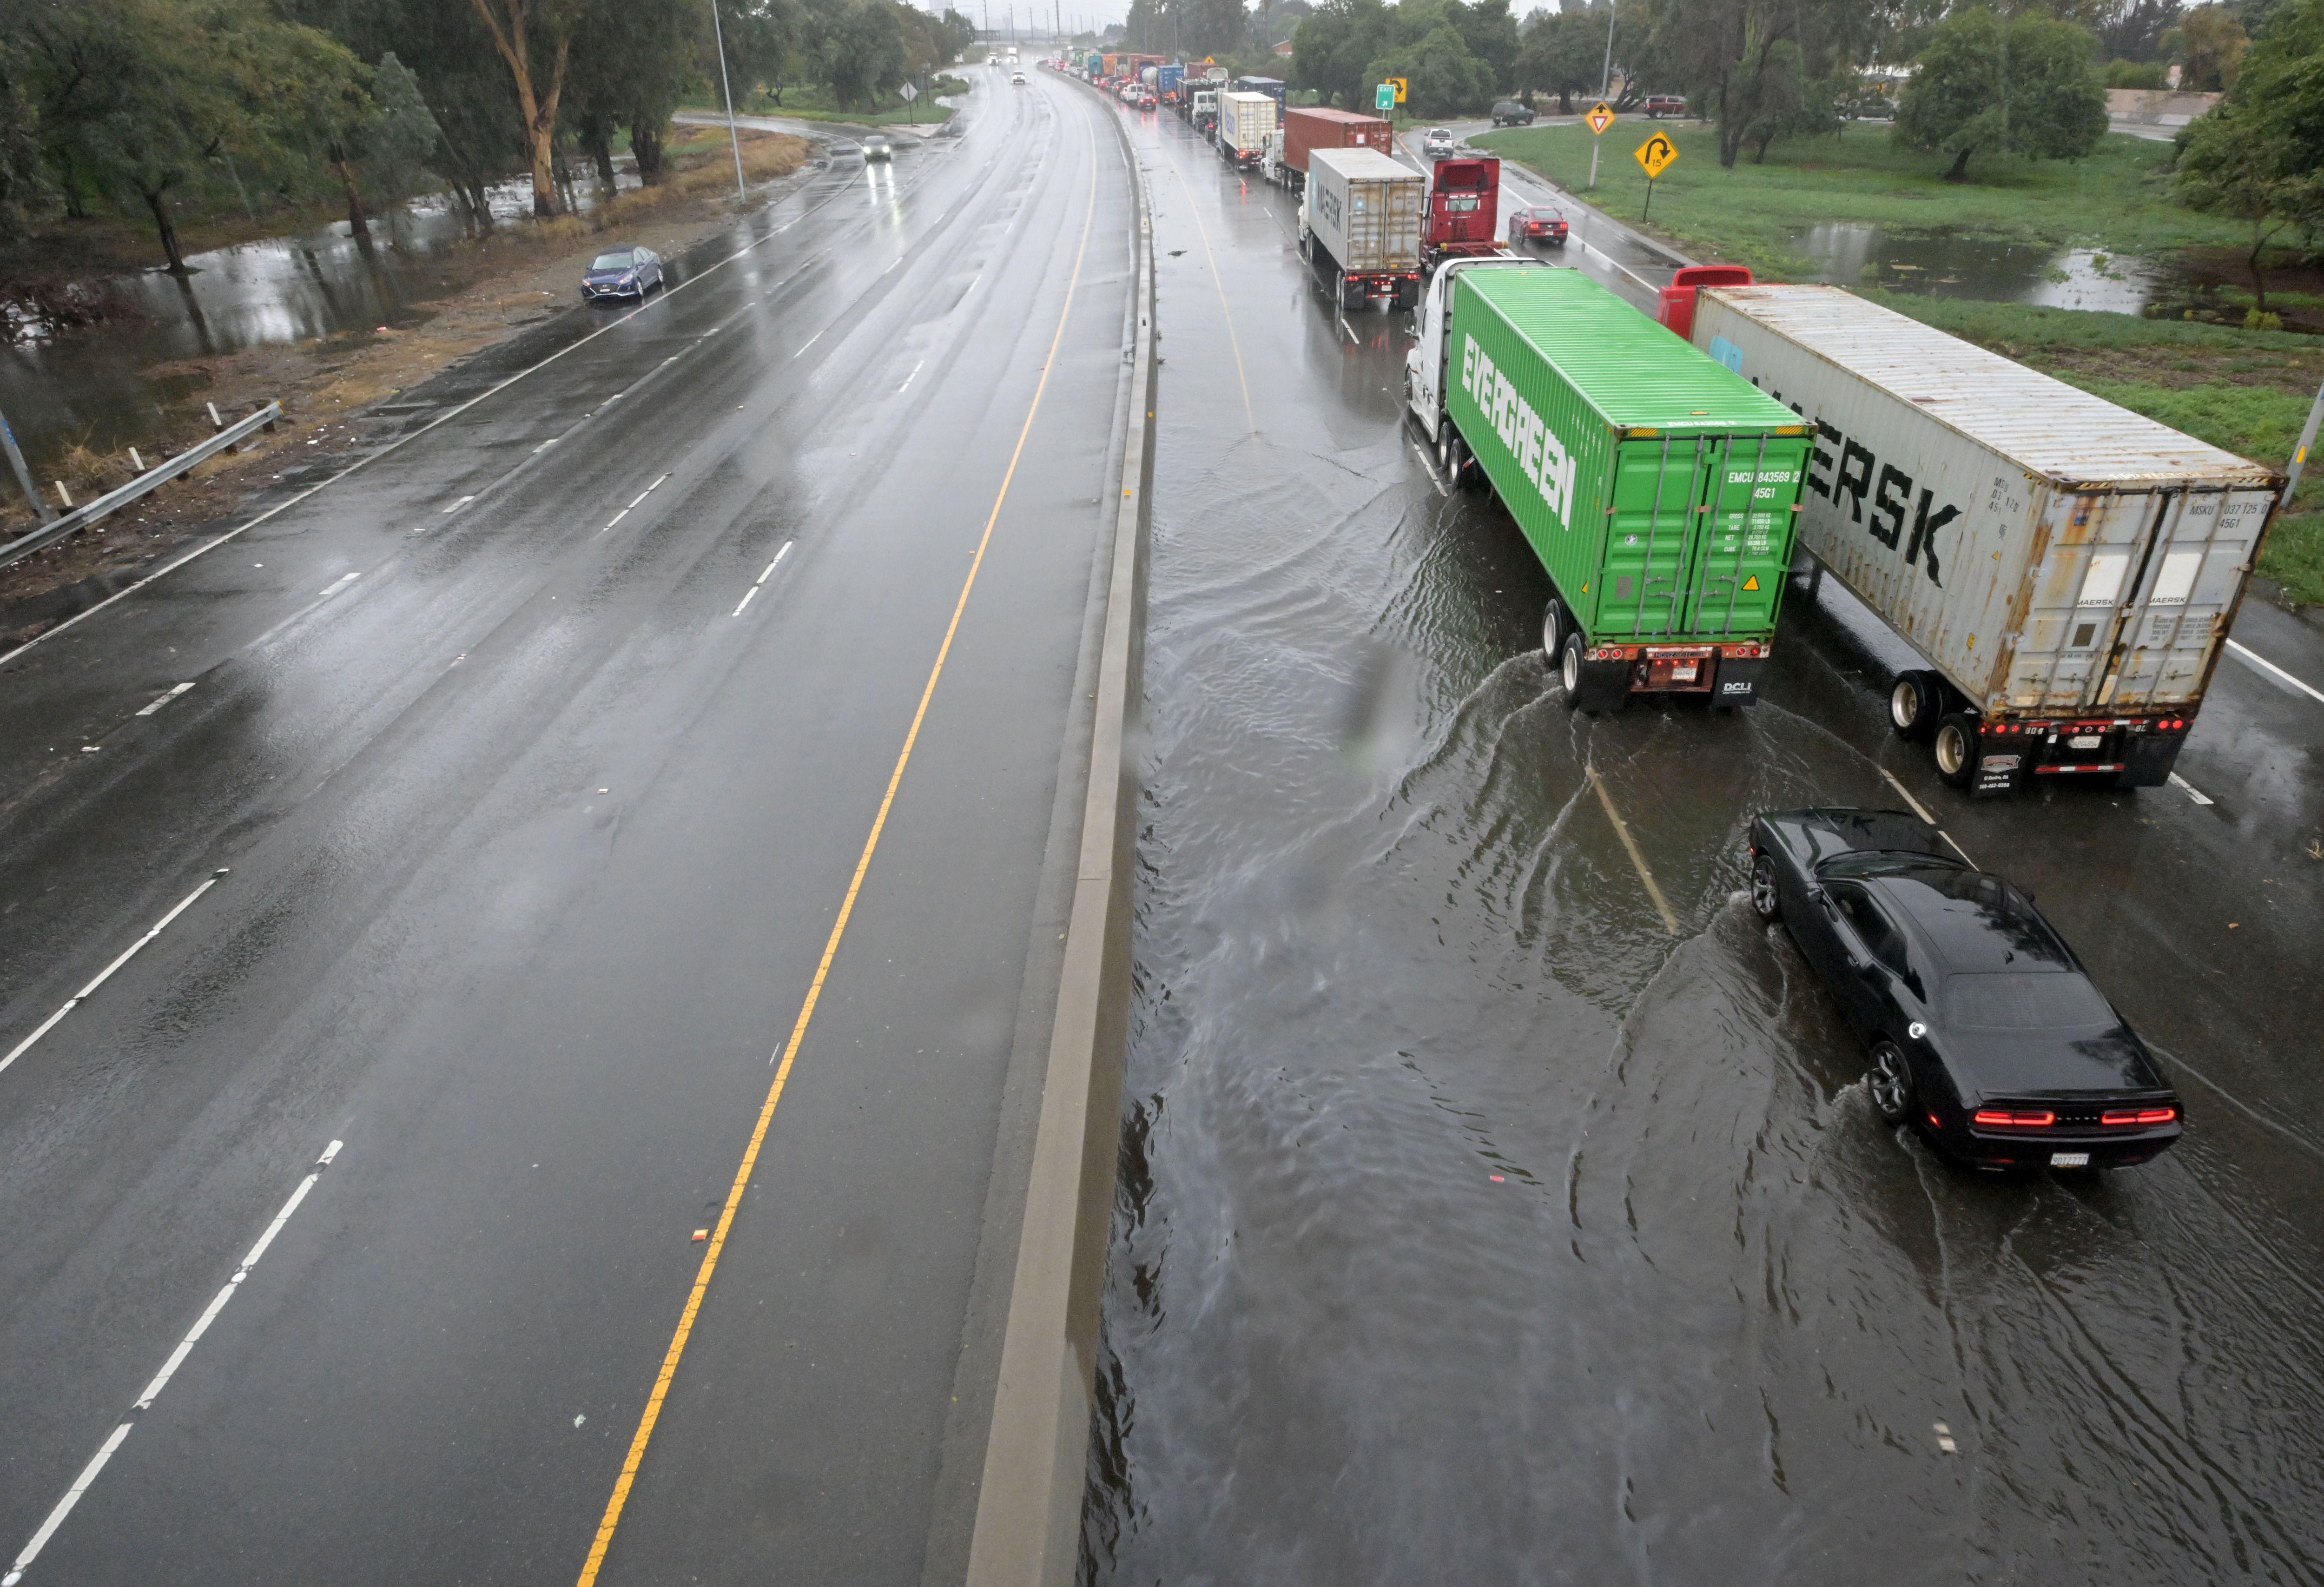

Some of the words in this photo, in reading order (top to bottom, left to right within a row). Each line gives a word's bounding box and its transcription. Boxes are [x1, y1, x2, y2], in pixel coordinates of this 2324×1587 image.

[1462, 333, 1576, 531] EVERGREEN
[1728, 472, 1754, 483] EMCU
[1757, 471, 1790, 483] 843569
[1793, 471, 1801, 483] 2
[1752, 377, 1963, 589] ERSK
[1754, 488, 1775, 498] 45G1
[2190, 505, 2215, 515] MSKU
[2224, 505, 2239, 514] 037
[2243, 504, 2257, 514] 125
[2261, 504, 2267, 514] 0
[2219, 518, 2240, 528] 45G1
[1723, 682, 1751, 691] DCLI
